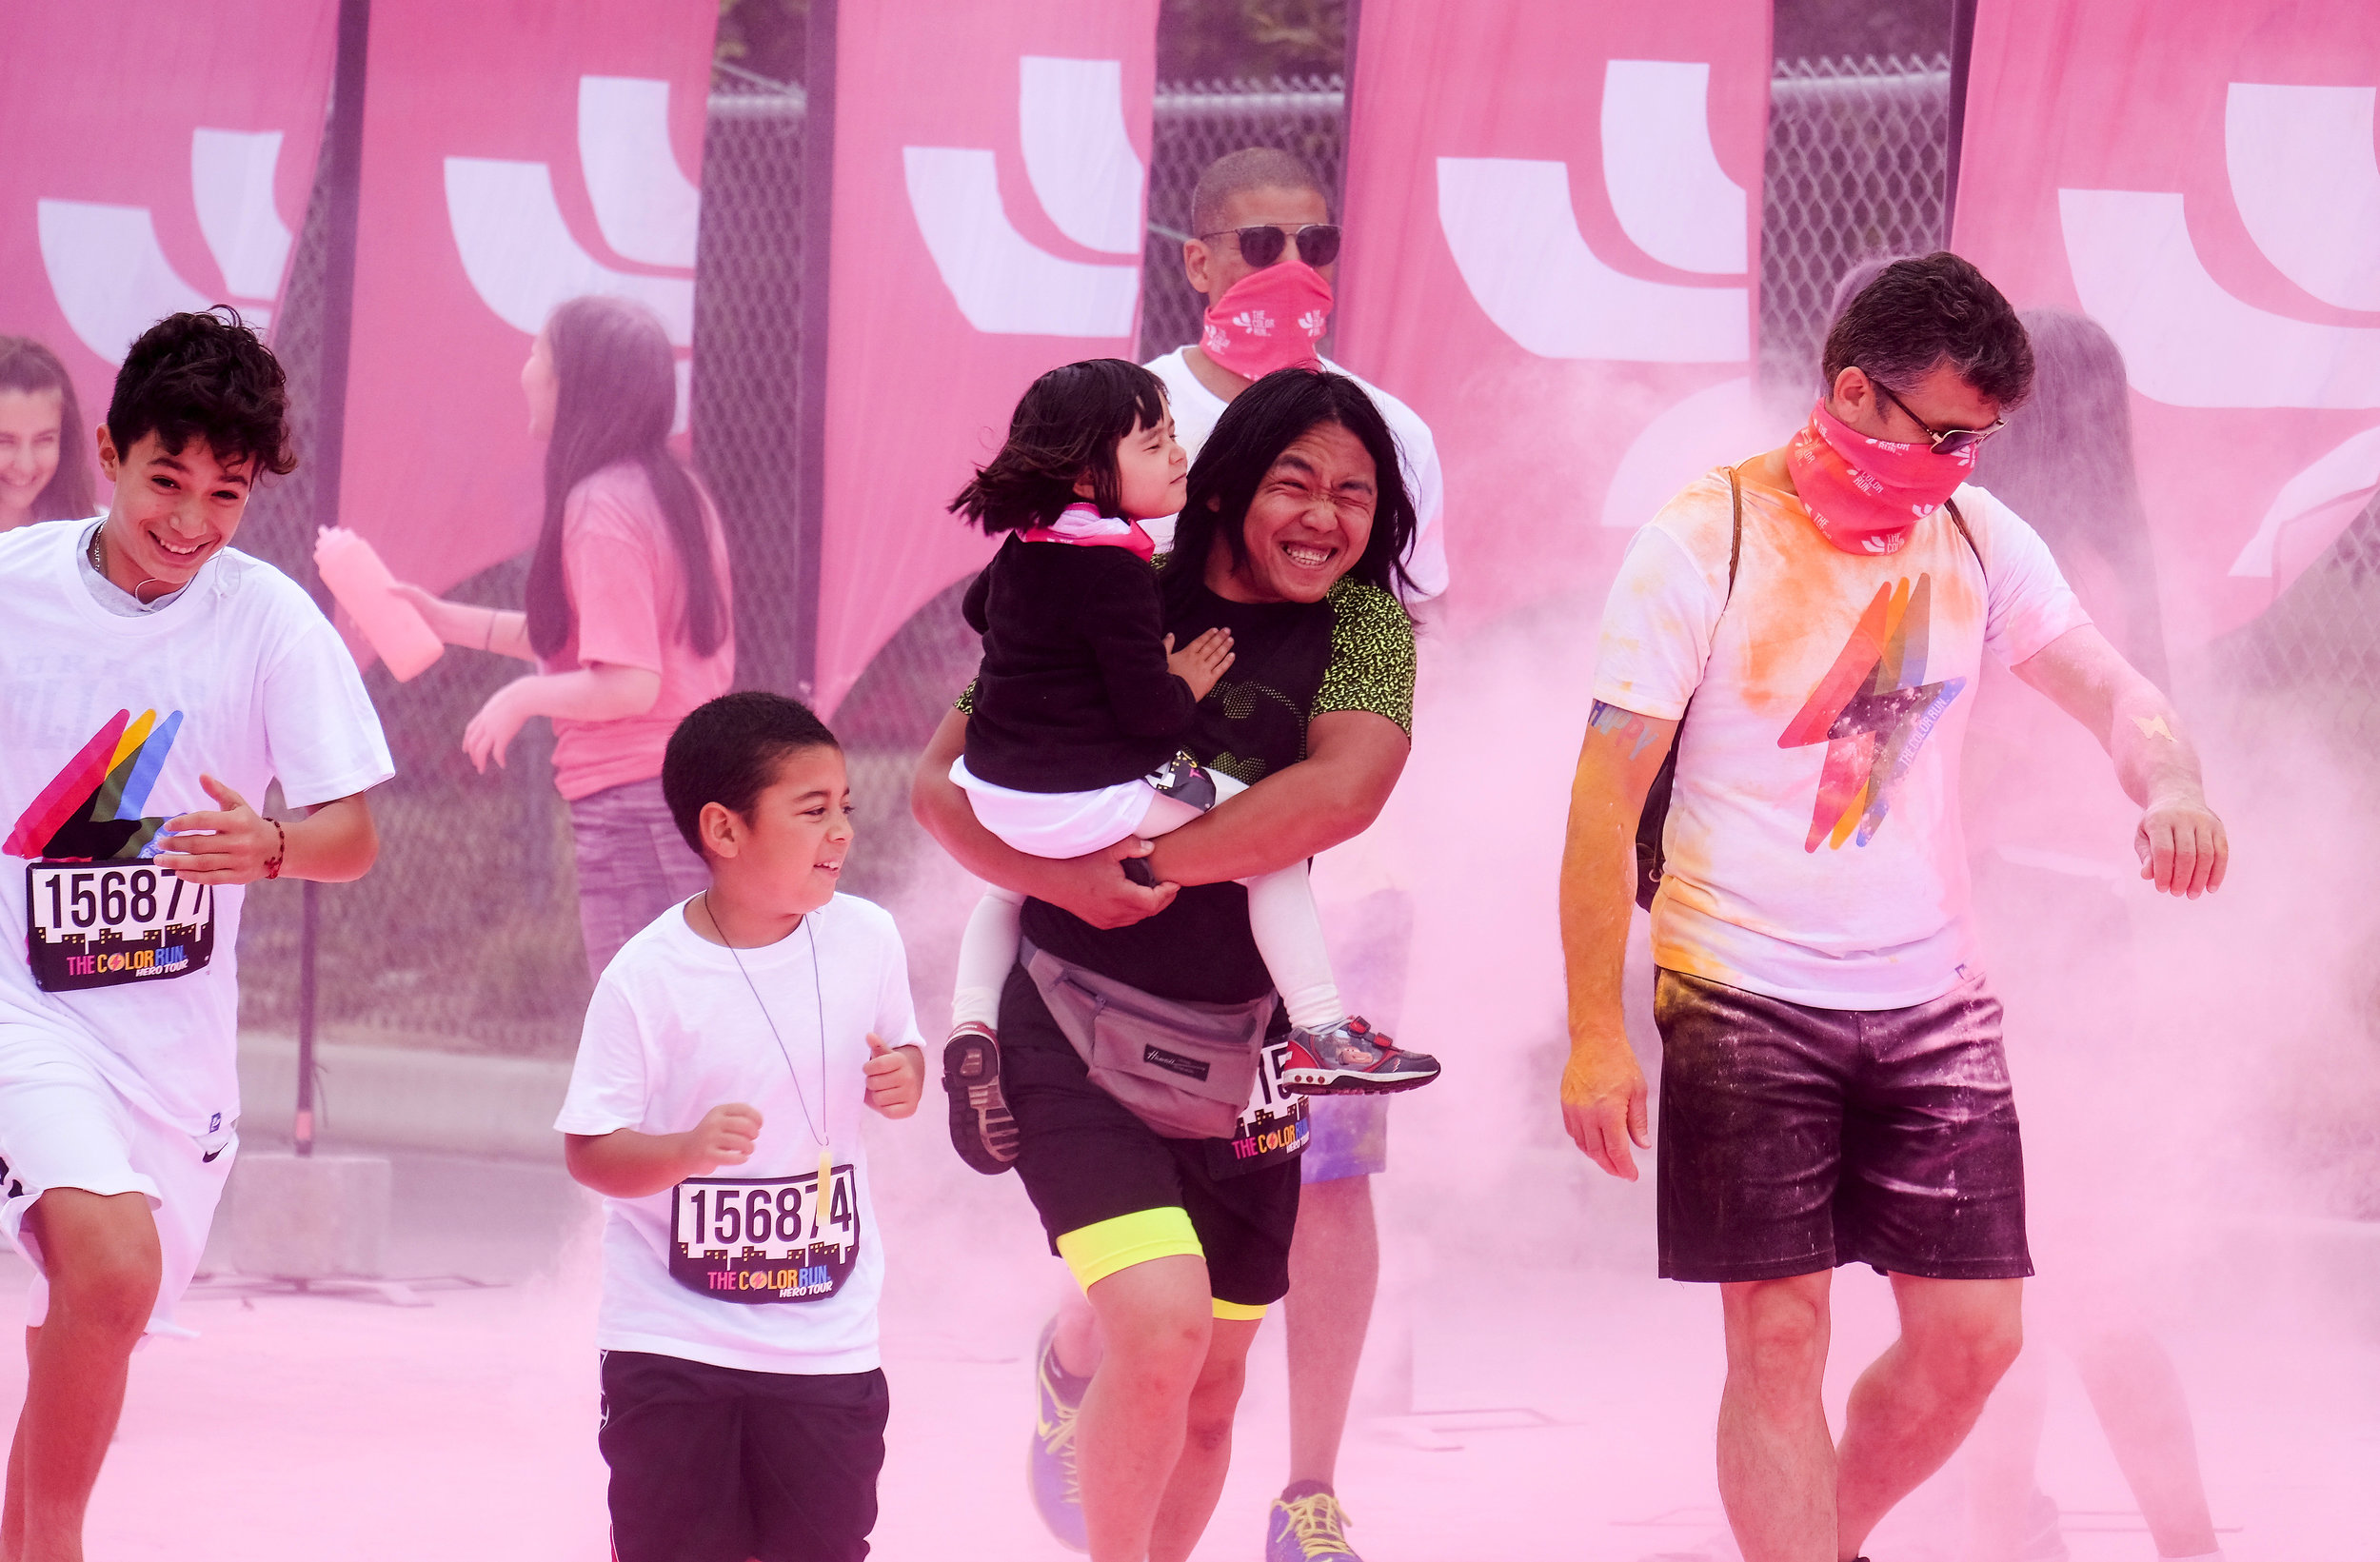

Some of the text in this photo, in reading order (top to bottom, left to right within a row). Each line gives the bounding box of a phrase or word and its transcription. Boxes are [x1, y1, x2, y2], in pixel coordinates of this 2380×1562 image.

[1814, 512, 1829, 528] THE
[1899, 745, 1916, 768] THE
[1909, 716, 1934, 750] COLOR
[66, 955, 95, 976] THE
[96, 949, 154, 973] COLOR
[135, 959, 188, 978] HERO TOUR
[1231, 1137, 1259, 1159] THE
[1258, 1124, 1296, 1154] COLOR
[691, 1176, 852, 1244] 156874
[707, 1271, 737, 1290] THE
[739, 1269, 798, 1290] COLOR
[779, 1281, 833, 1297] HERO TOUR
